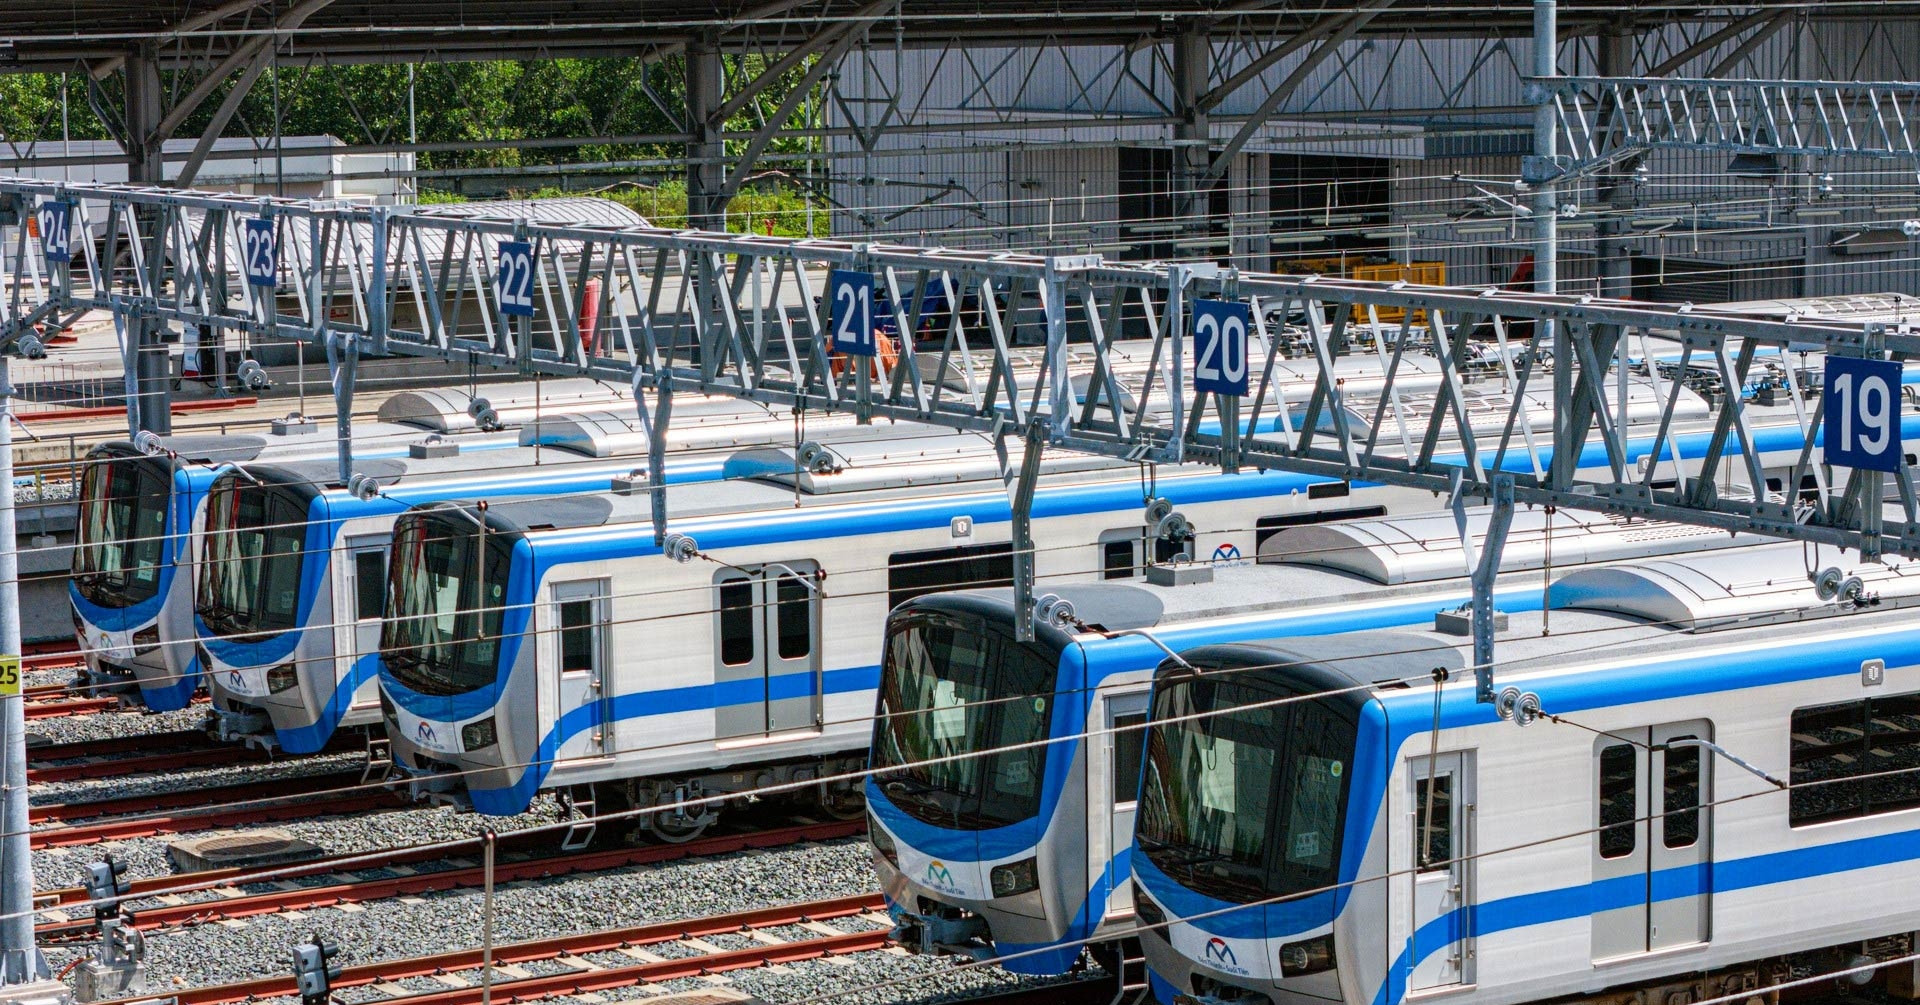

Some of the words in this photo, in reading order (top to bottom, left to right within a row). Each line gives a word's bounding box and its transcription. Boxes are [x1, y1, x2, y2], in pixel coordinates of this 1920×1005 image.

[44, 210, 68, 254] 24
[247, 229, 274, 277] 23
[500, 252, 530, 305] 22
[837, 283, 870, 344] 21
[1196, 313, 1245, 382] 20
[1834, 373, 1891, 455] 19
